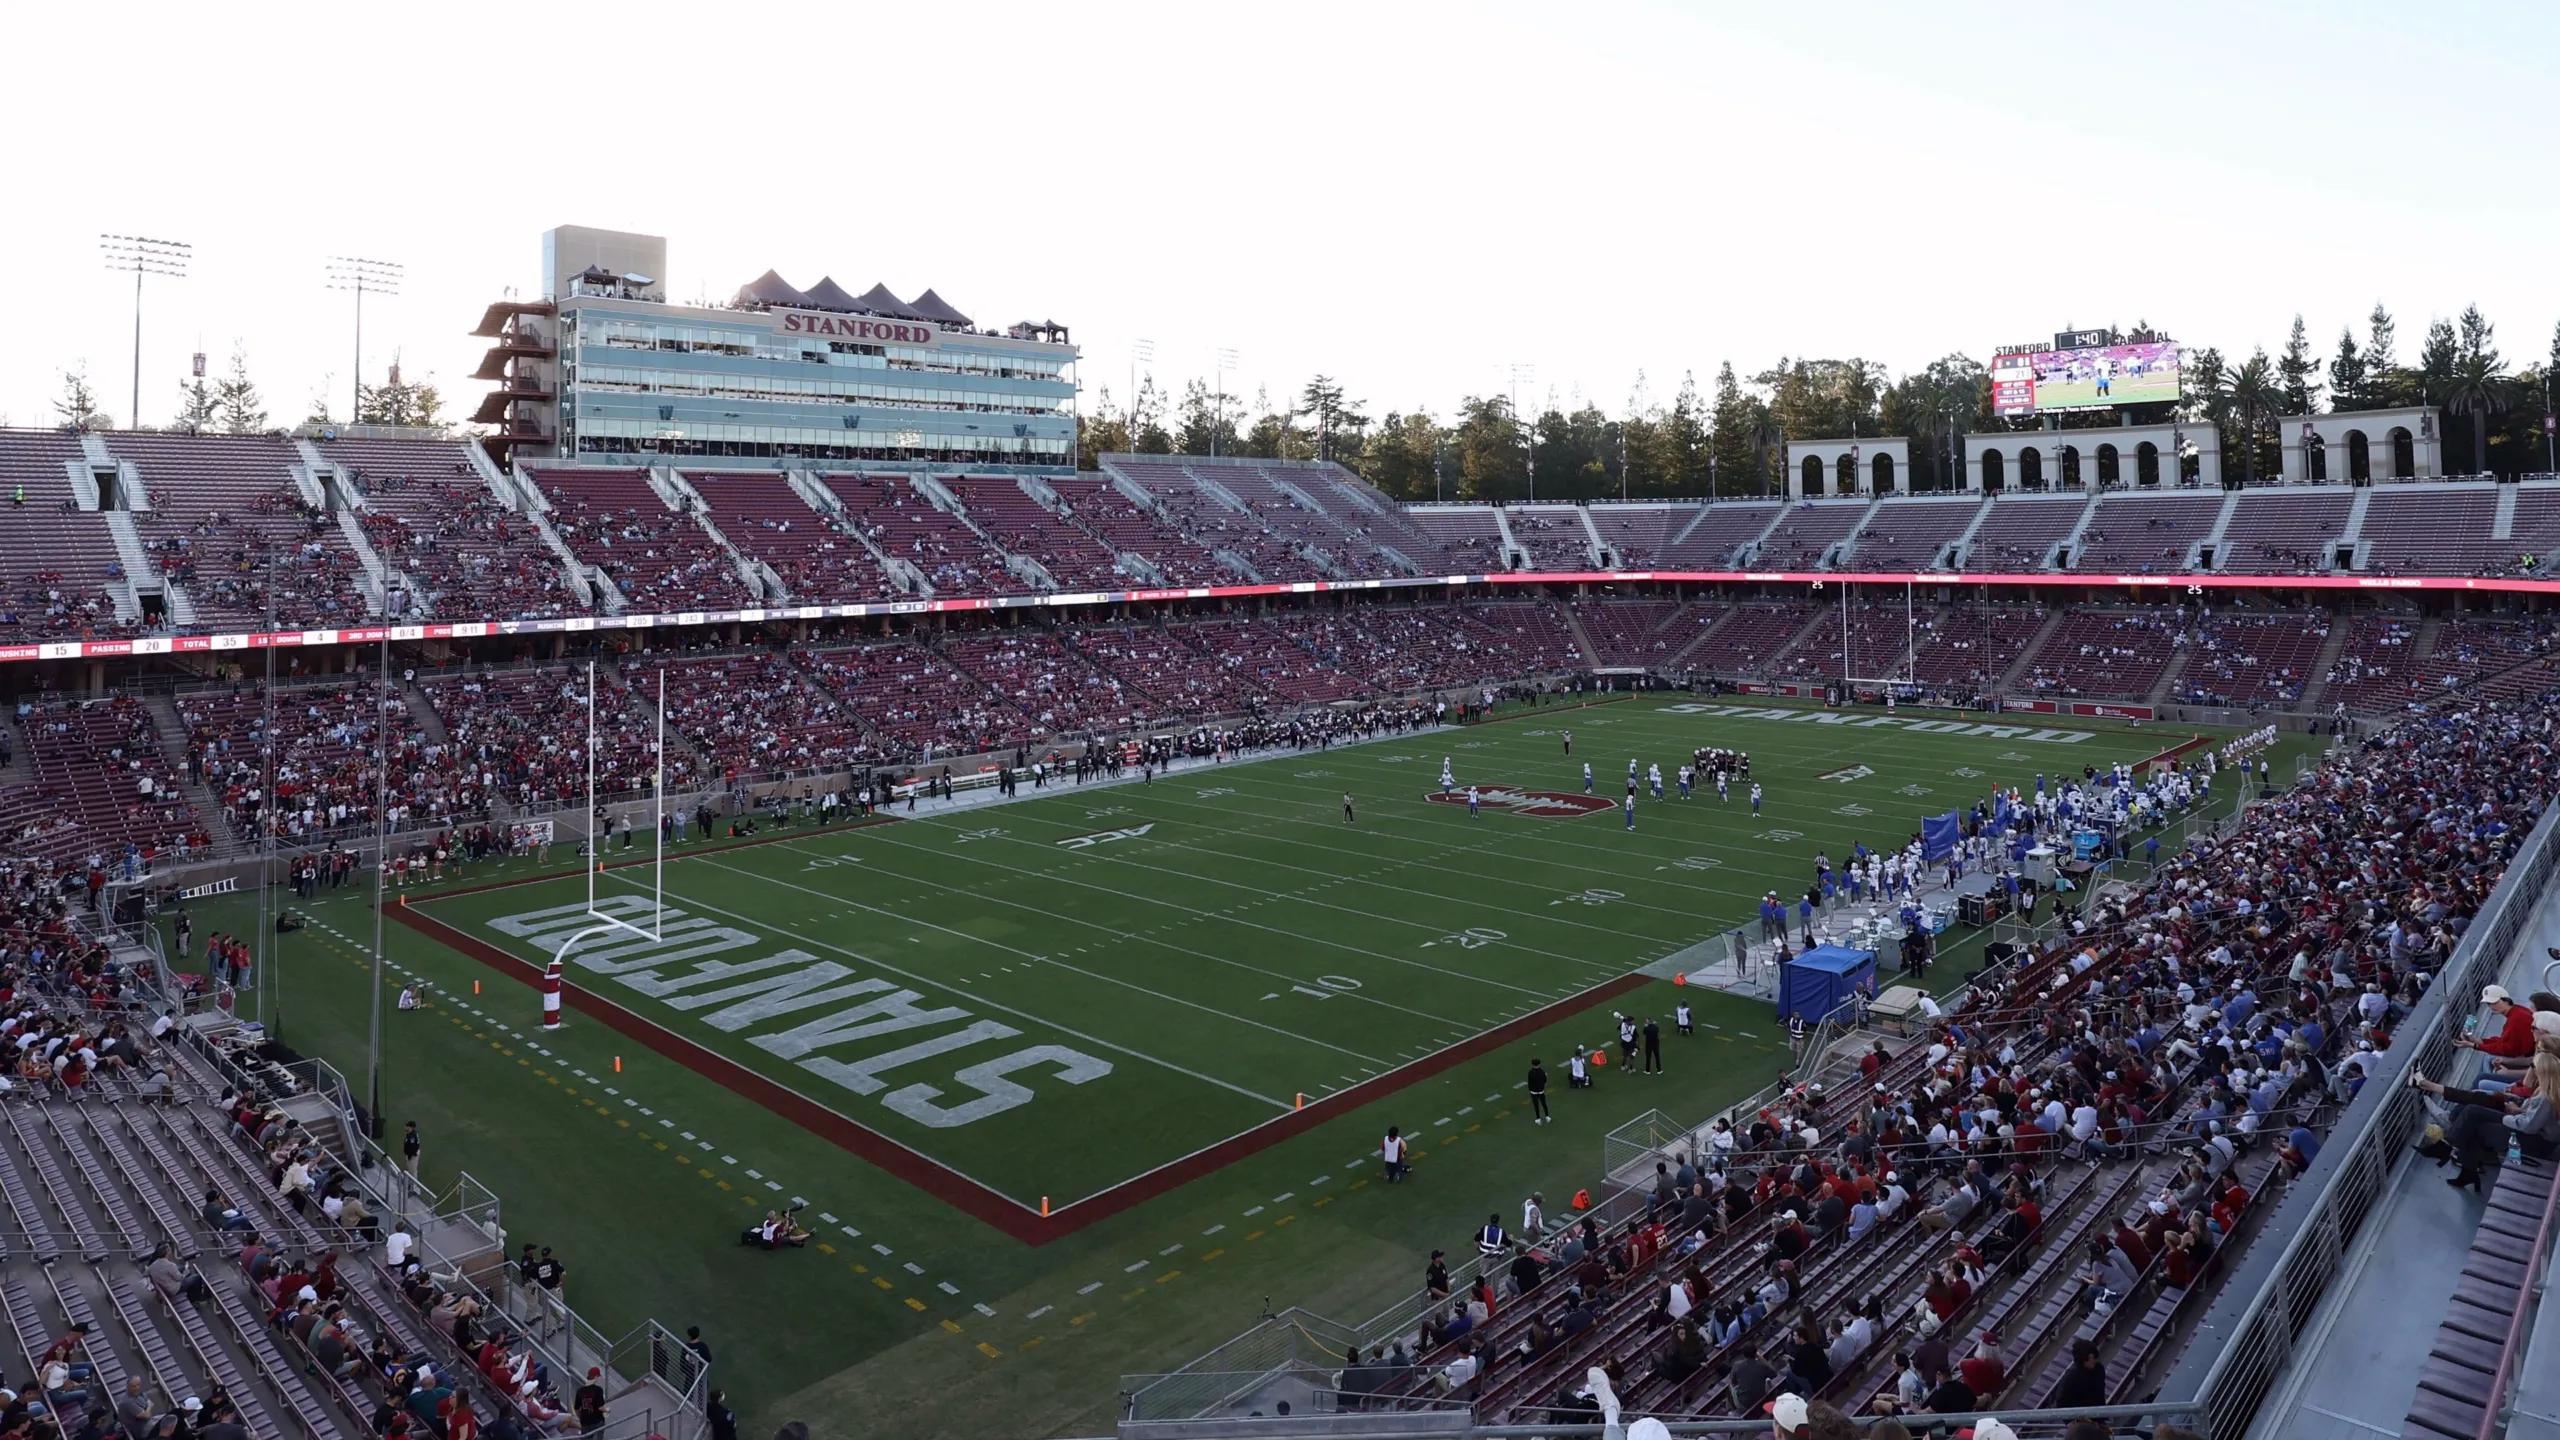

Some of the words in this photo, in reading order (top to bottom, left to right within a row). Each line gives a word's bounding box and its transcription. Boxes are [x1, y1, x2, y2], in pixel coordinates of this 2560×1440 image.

[784, 312, 932, 344] STANFORD
[2075, 332, 2099, 346] 1:40
[1995, 342, 2051, 357] STANFORD
[1812, 580, 1823, 589] 25
[2117, 576, 2142, 584] WELLS
[2143, 576, 2169, 584] FARGO
[2359, 579, 2389, 587] WELLS
[2391, 579, 2422, 587] FARGO
[2187, 584, 2203, 595] 25
[536, 622, 565, 630] RUSHING
[574, 619, 586, 629] 38
[600, 619, 627, 627] PASSING
[660, 616, 678, 624] TOTAL
[54, 646, 68, 656] 15
[91, 644, 131, 654] PASSING
[145, 640, 160, 651] 20
[182, 640, 209, 648] TOTAL
[222, 637, 237, 647] 35
[276, 635, 302, 643] DOWNS
[317, 632, 324, 642] 4
[348, 632, 363, 640] 3RD
[2002, 700, 2034, 709] STANFORD
[1654, 703, 2098, 744] STANFORD
[1818, 764, 1876, 783] ACC
[1056, 822, 1156, 850] ACC
[807, 854, 865, 870] 10
[1566, 888, 1626, 905] 30
[1440, 927, 1507, 949] 20
[1290, 975, 1363, 1001] 10
[485, 894, 1114, 1129] STANFORD
[2260, 1048, 2276, 1056] SMU
